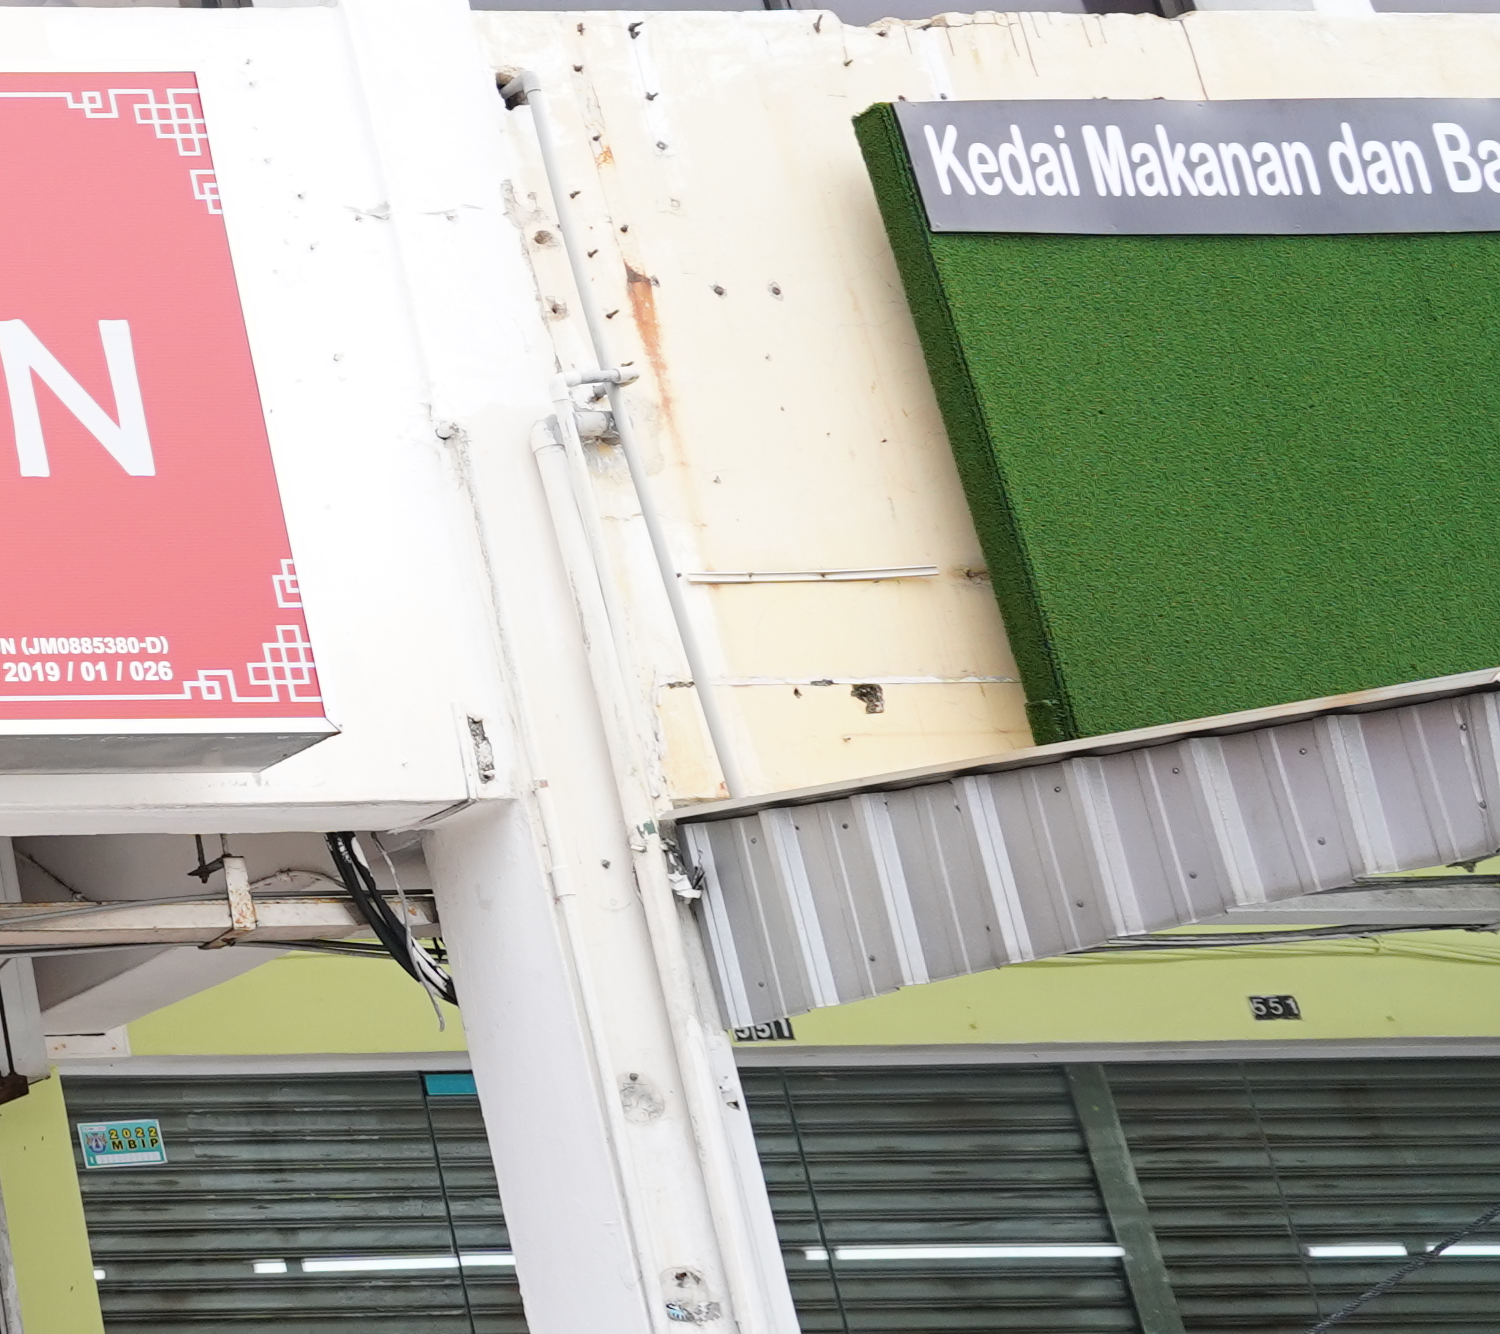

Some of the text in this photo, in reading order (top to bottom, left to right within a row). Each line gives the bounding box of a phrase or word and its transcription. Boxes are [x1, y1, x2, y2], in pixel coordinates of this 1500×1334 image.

[924, 124, 1080, 197] Kedai
[1082, 124, 1321, 197] Makanan
[1328, 122, 1432, 195] dan
[20, 635, 169, 657] (JM0885380-D)
[2, 661, 61, 682] 2019
[80, 661, 108, 682] 01
[129, 660, 174, 682] 026
[1250, 998, 1299, 1016] 551
[109, 1126, 158, 1140] 2022
[111, 1138, 159, 1150] MBIP
